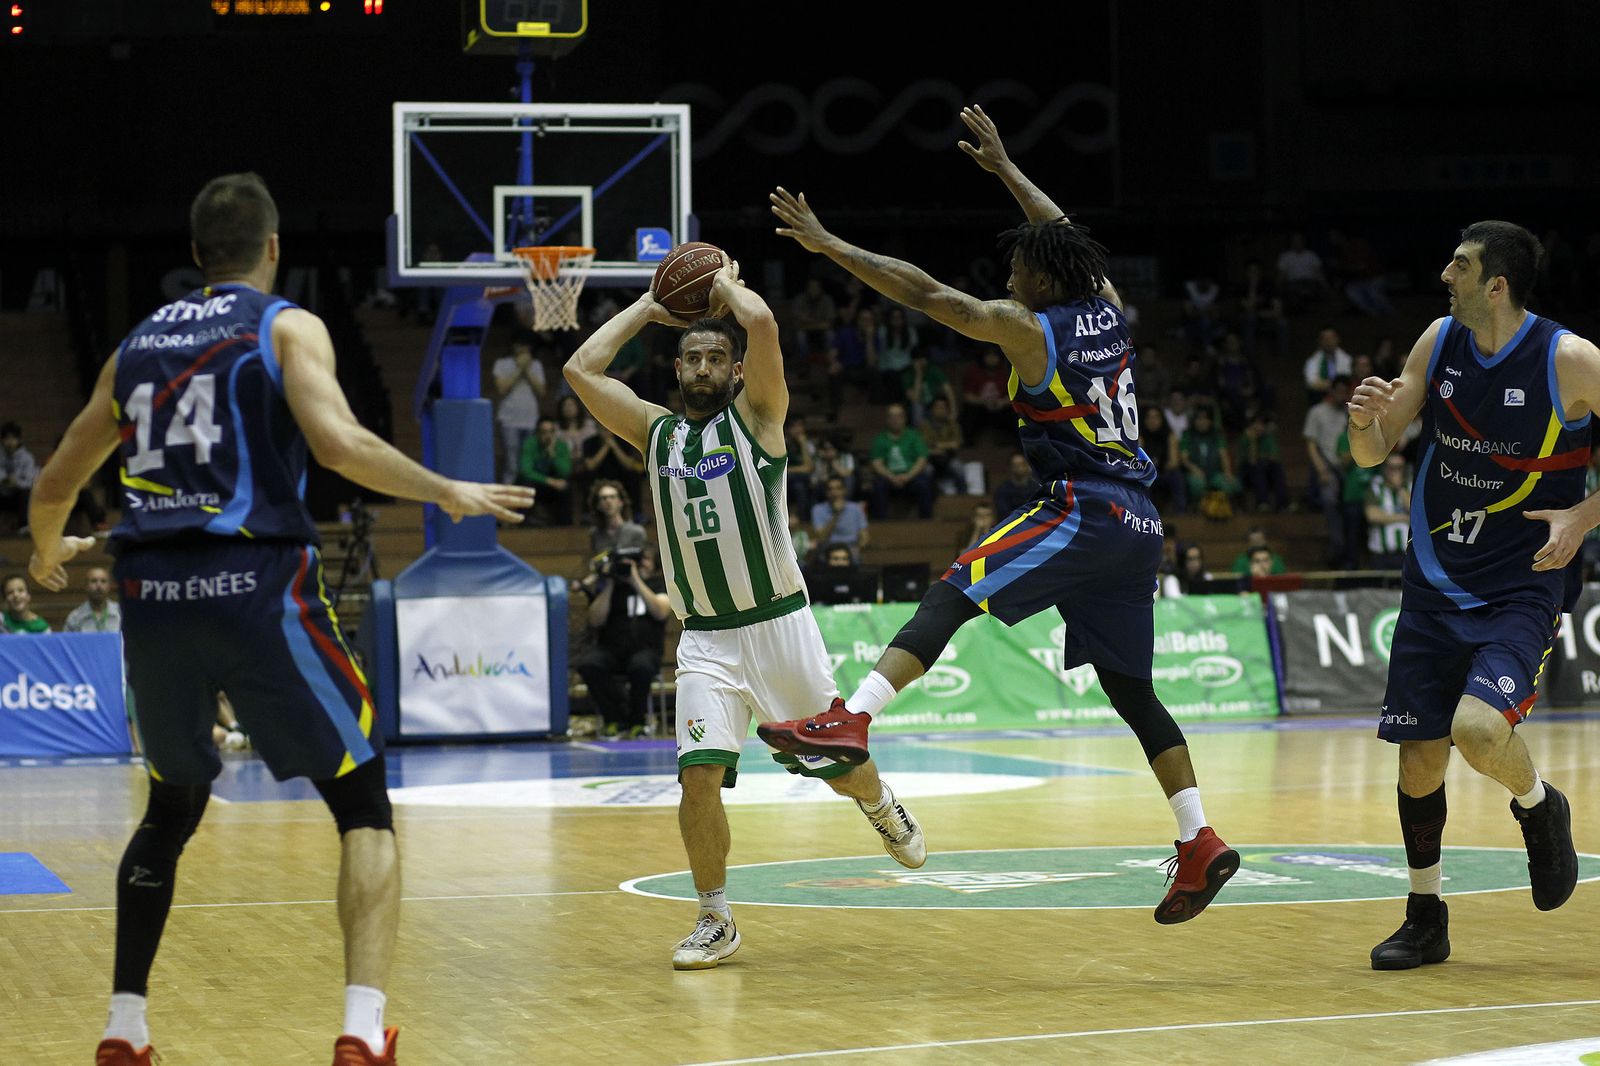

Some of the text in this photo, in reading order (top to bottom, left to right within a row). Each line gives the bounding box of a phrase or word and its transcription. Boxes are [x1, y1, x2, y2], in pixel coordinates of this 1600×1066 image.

[668, 252, 721, 287] SPALDING
[1081, 337, 1134, 363] MORABAC
[1087, 368, 1139, 442] 16
[124, 373, 222, 476] 14
[1441, 432, 1521, 456] MORABANC
[699, 454, 728, 477] plus
[683, 498, 721, 538] 16
[1447, 508, 1487, 545] 17
[0, 672, 97, 712] desa
